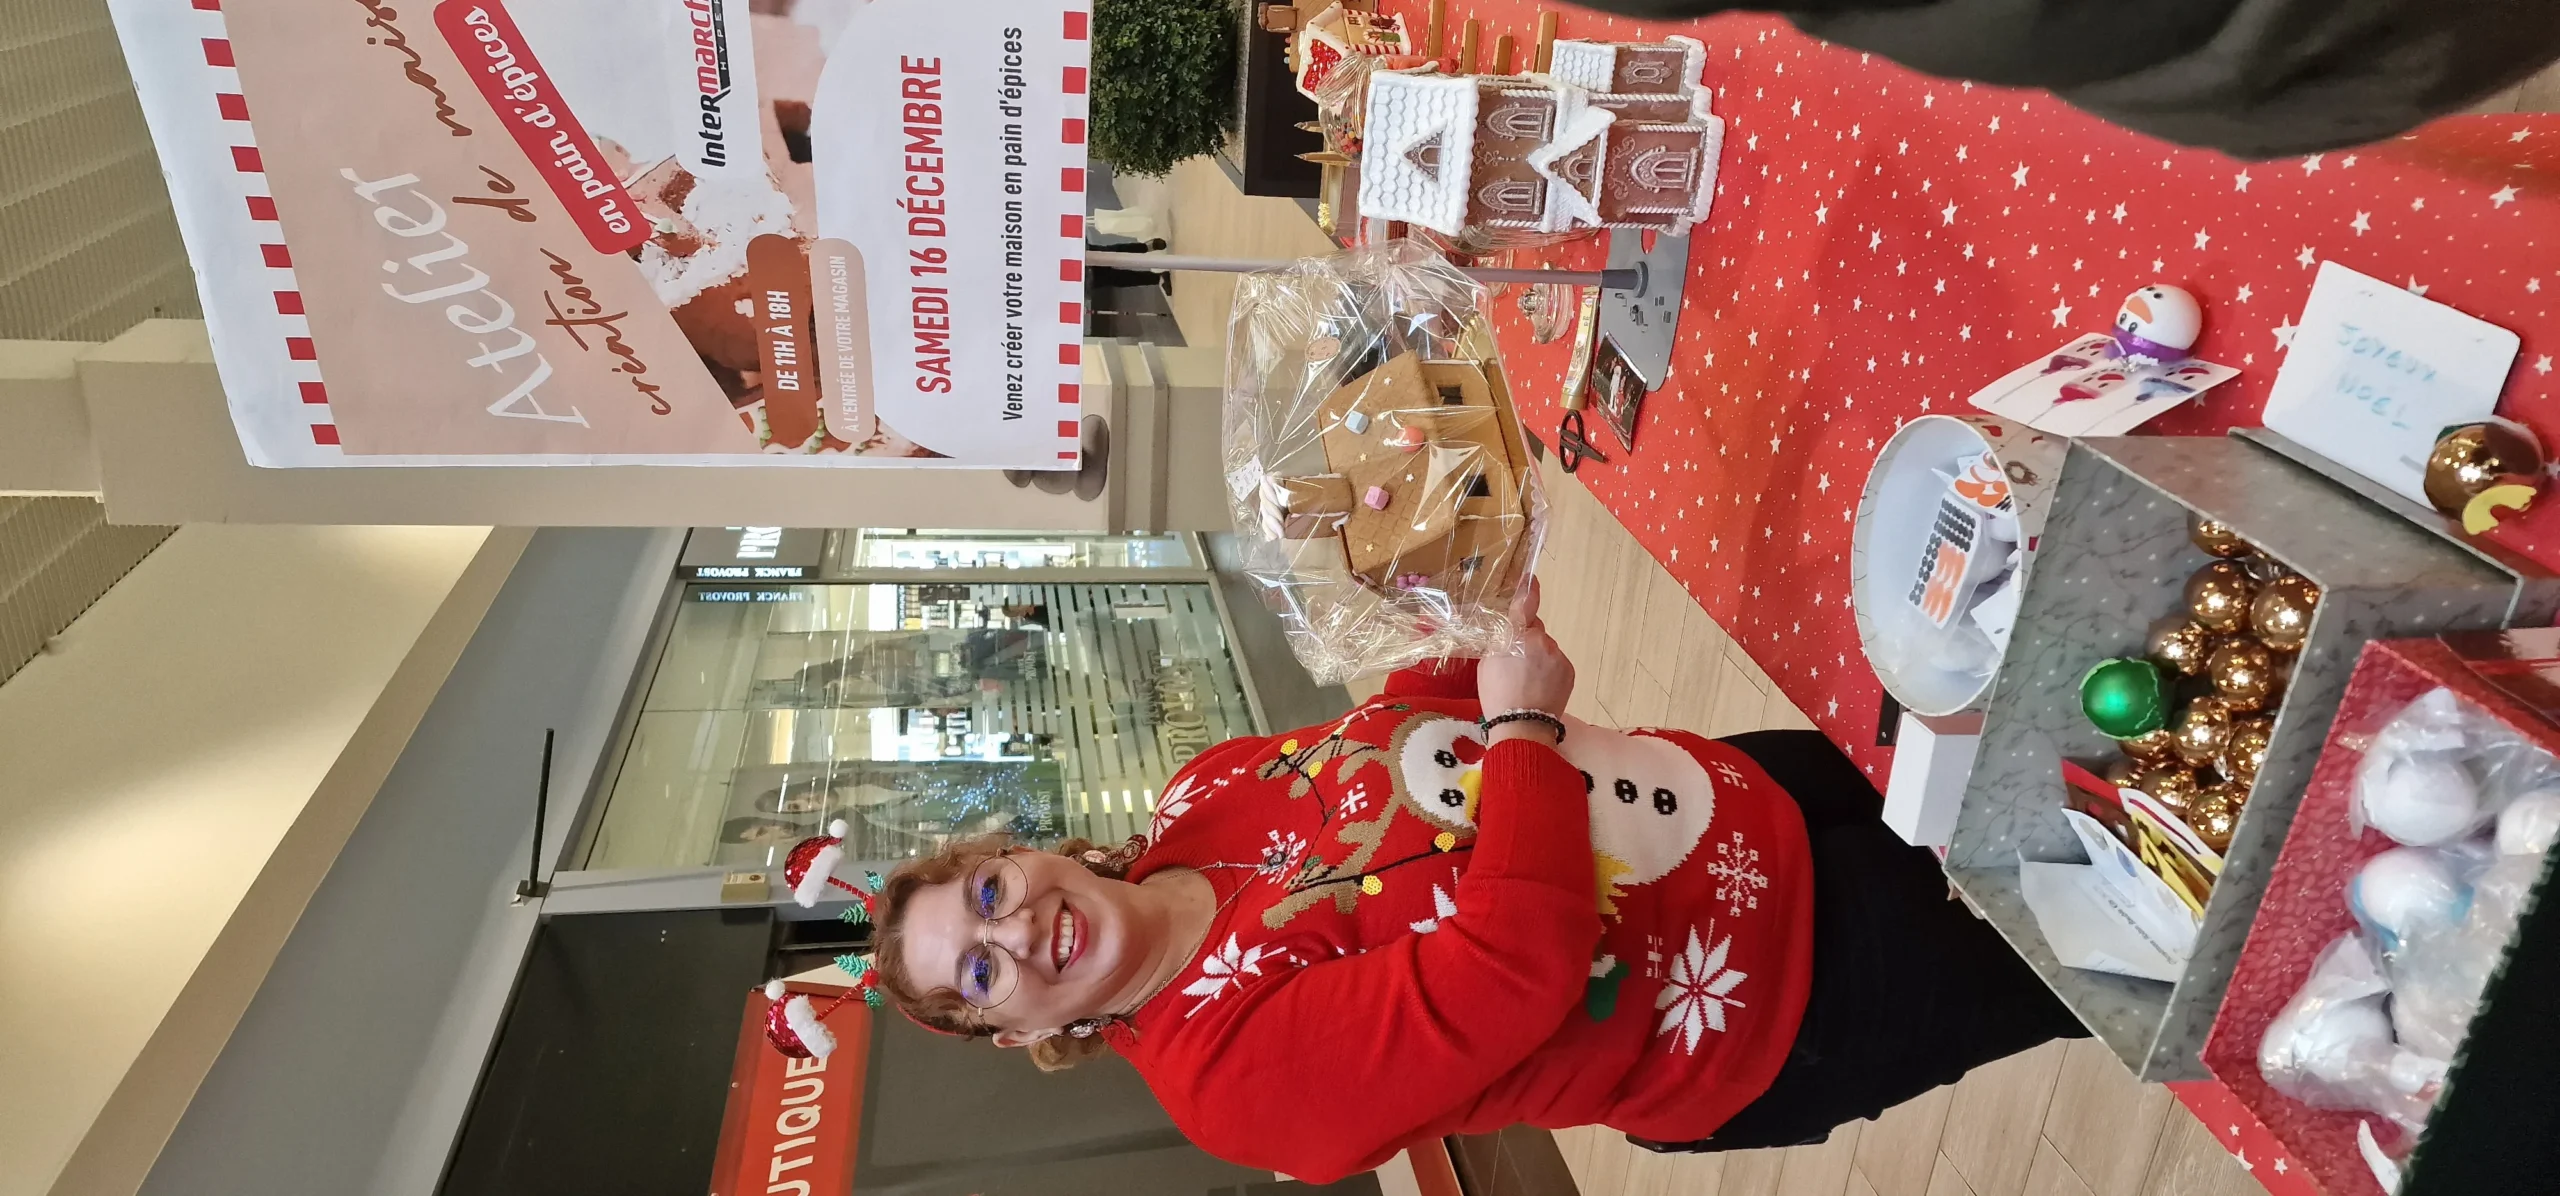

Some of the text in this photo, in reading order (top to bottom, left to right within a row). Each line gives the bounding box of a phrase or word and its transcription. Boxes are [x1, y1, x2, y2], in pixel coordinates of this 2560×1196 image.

[452, 165, 536, 222] de
[464, 6, 631, 234] en pain d'épices
[339, 168, 590, 428] Atelier
[897, 55, 951, 394] SAMEDI 16 DÉCEMBRE
[998, 27, 1027, 421] Venez créer votre maison en pain d'épices
[540, 248, 672, 415] création
[765, 290, 800, 391] DE 11H À 18H
[829, 255, 860, 432] À L'ENTRÉE DE VOTRE MAGASIN
[696, 567, 802, 577] FRANCK PROVOST
[766, 1055, 829, 1196] UTIQUE
